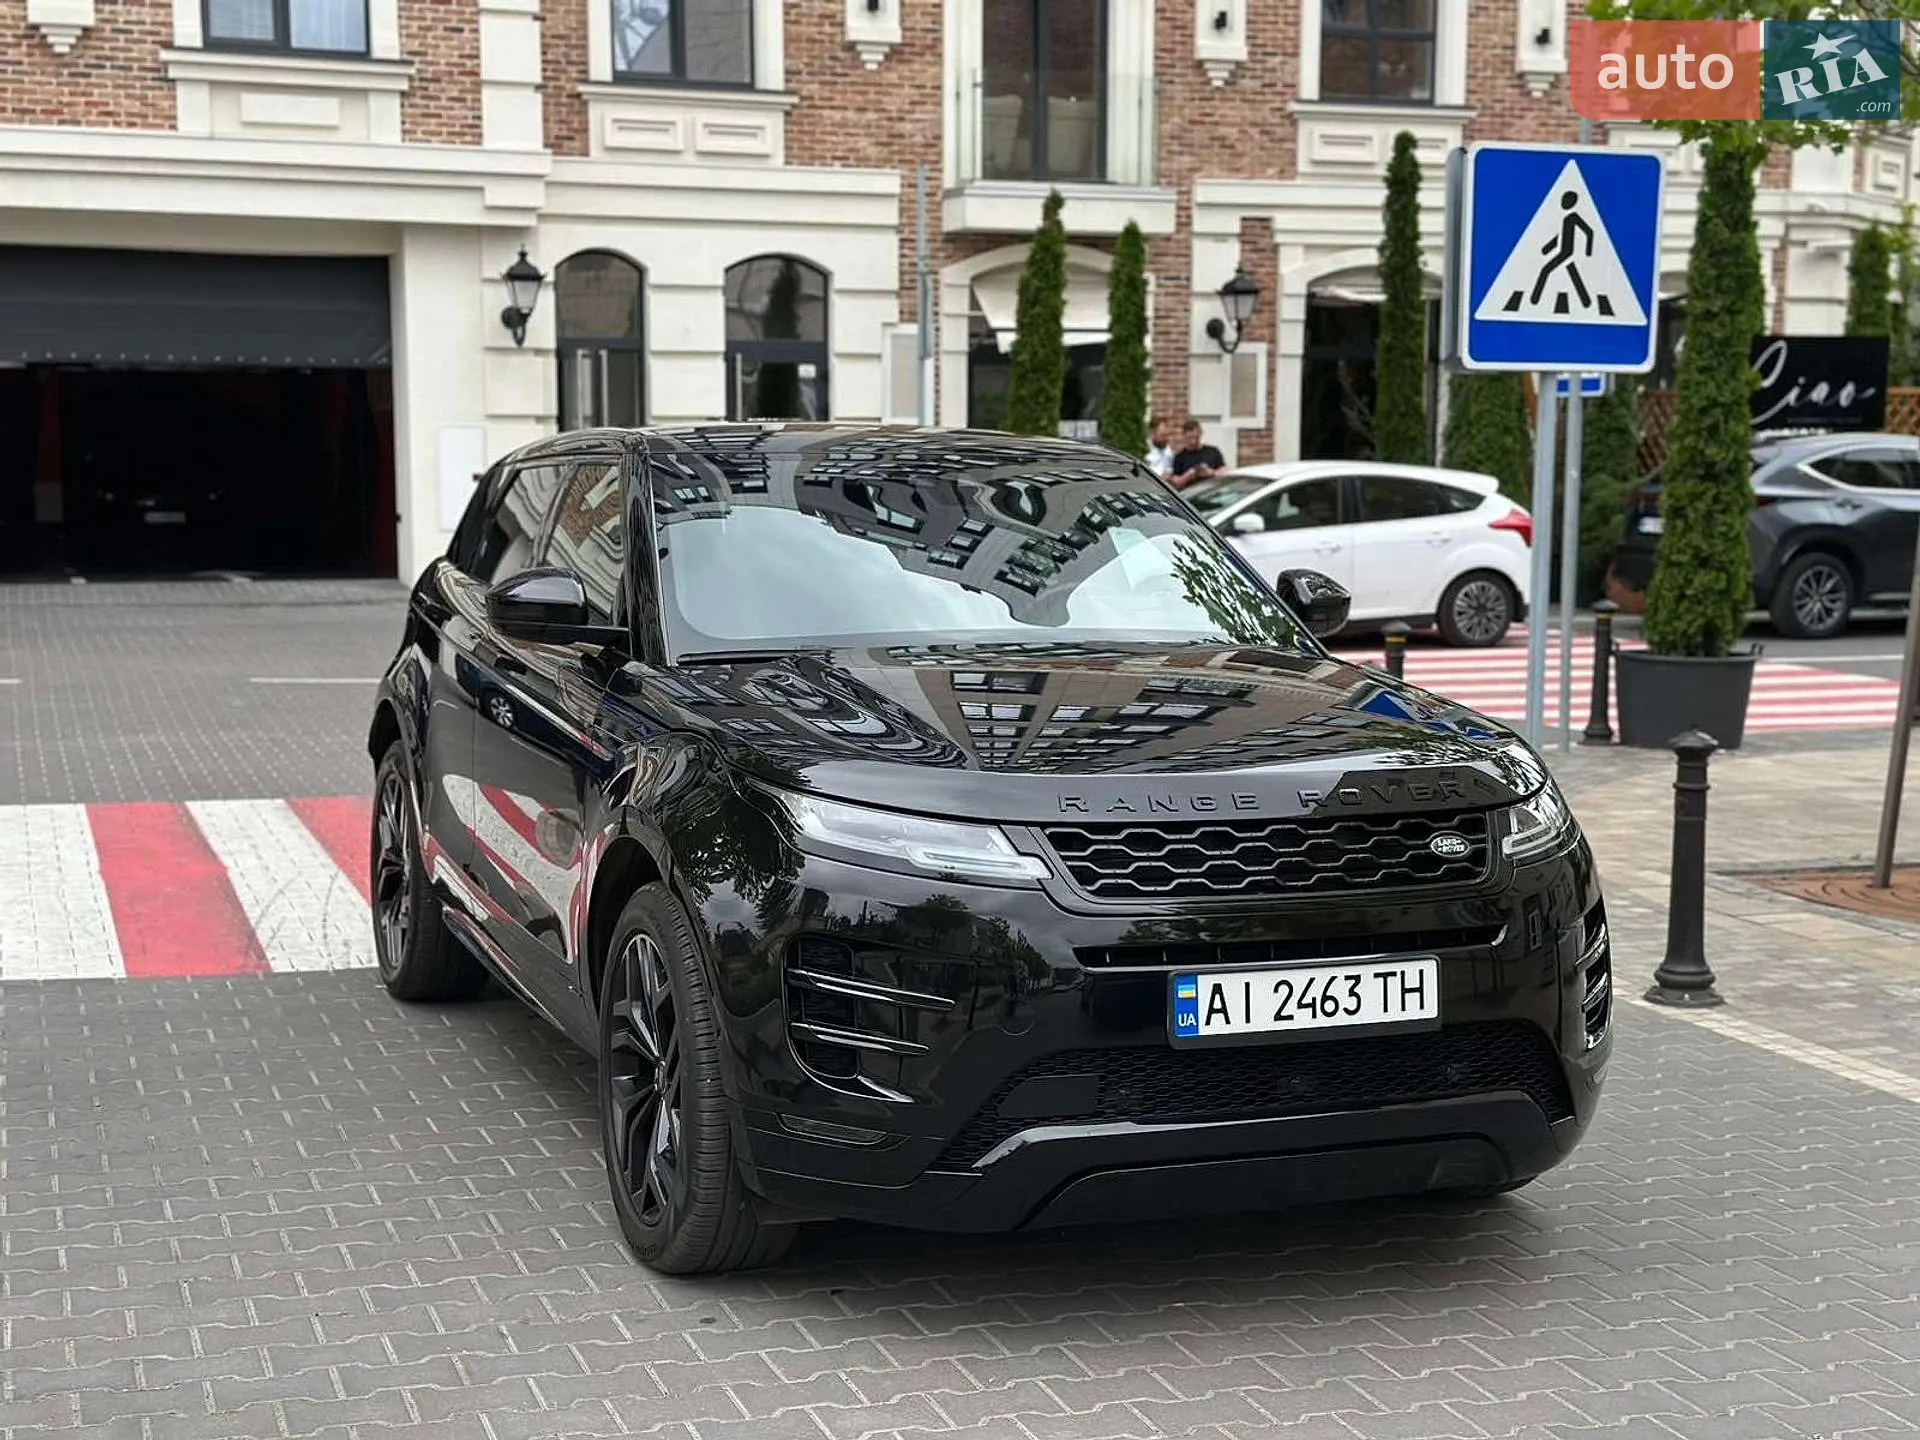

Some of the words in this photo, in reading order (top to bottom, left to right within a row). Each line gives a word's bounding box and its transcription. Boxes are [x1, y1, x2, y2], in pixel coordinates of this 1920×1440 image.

[1058, 791, 1259, 813] RANGE
[1297, 779, 1464, 809] ROVER
[1273, 974, 1362, 1022] 2463
[1373, 968, 1425, 1013] TH
[1178, 1014, 1196, 1026] UA
